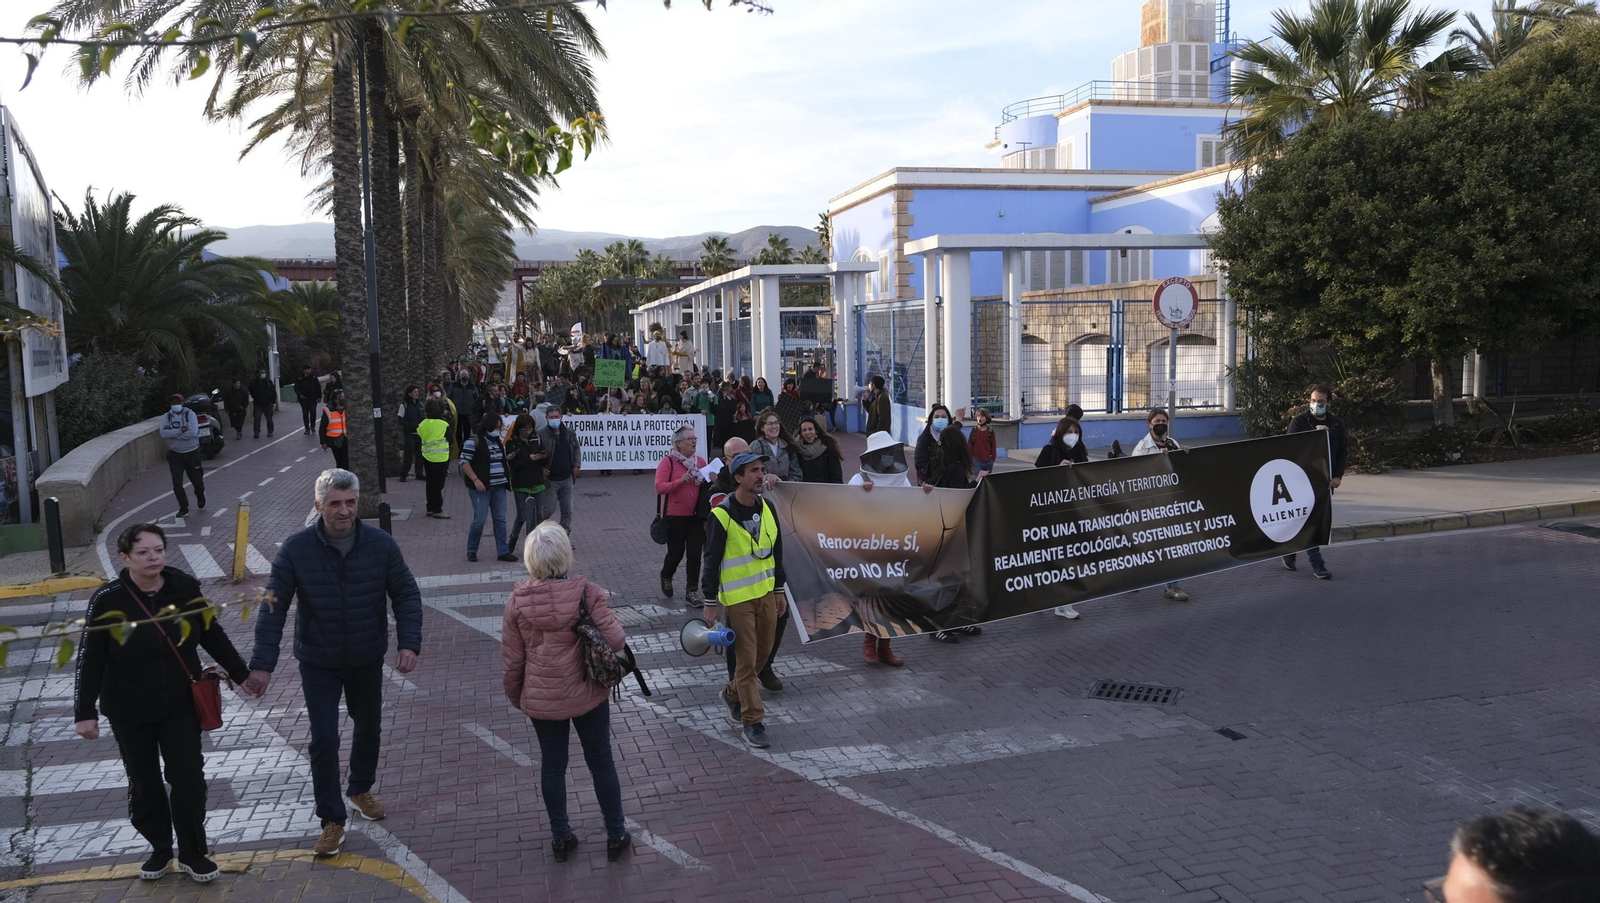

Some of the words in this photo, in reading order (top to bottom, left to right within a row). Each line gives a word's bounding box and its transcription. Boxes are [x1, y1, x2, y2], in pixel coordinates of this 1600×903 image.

[1162, 277, 1191, 288] EXCEPTO
[564, 420, 604, 431] TAFORMA
[607, 420, 629, 431] PARA
[631, 420, 640, 431] LA
[578, 436, 604, 447] VALLE
[607, 436, 613, 447] Y
[615, 436, 626, 446] LA
[628, 433, 642, 446] VÍA
[645, 435, 671, 446] VERDE
[582, 451, 613, 462] AINENA
[616, 451, 626, 462] DE
[629, 451, 645, 461] LAS
[648, 450, 670, 461] TORR
[1029, 488, 1077, 508] ALIANZA
[1077, 479, 1119, 501] ENERGÍA
[1119, 481, 1126, 494] Y
[1126, 472, 1180, 493] TERRITORIO
[1022, 526, 1049, 542] POR
[1051, 521, 1077, 538] UNA
[1078, 509, 1140, 534] TRANSICIÓN
[1140, 500, 1205, 522] ENERGÉTICA
[1262, 506, 1308, 524] ALIENTE
[817, 533, 900, 550] Renovables
[903, 531, 920, 553] SÍ,
[994, 545, 1065, 571] REALMENTE
[1066, 534, 1132, 558] ECOLÓGICA,
[1132, 522, 1193, 545] SOSTENIBLE
[1193, 520, 1201, 533] Y
[1203, 514, 1237, 532] JUSTA
[827, 567, 858, 582] pero
[859, 563, 883, 578] NO
[886, 559, 909, 578] ASÍ.
[1005, 574, 1034, 592] CON
[1034, 566, 1076, 586] TODAS
[1077, 562, 1097, 578] LAS
[1098, 550, 1156, 574] PERSONAS
[1155, 548, 1163, 561] Y
[1164, 535, 1231, 560] TERRITORIOS
